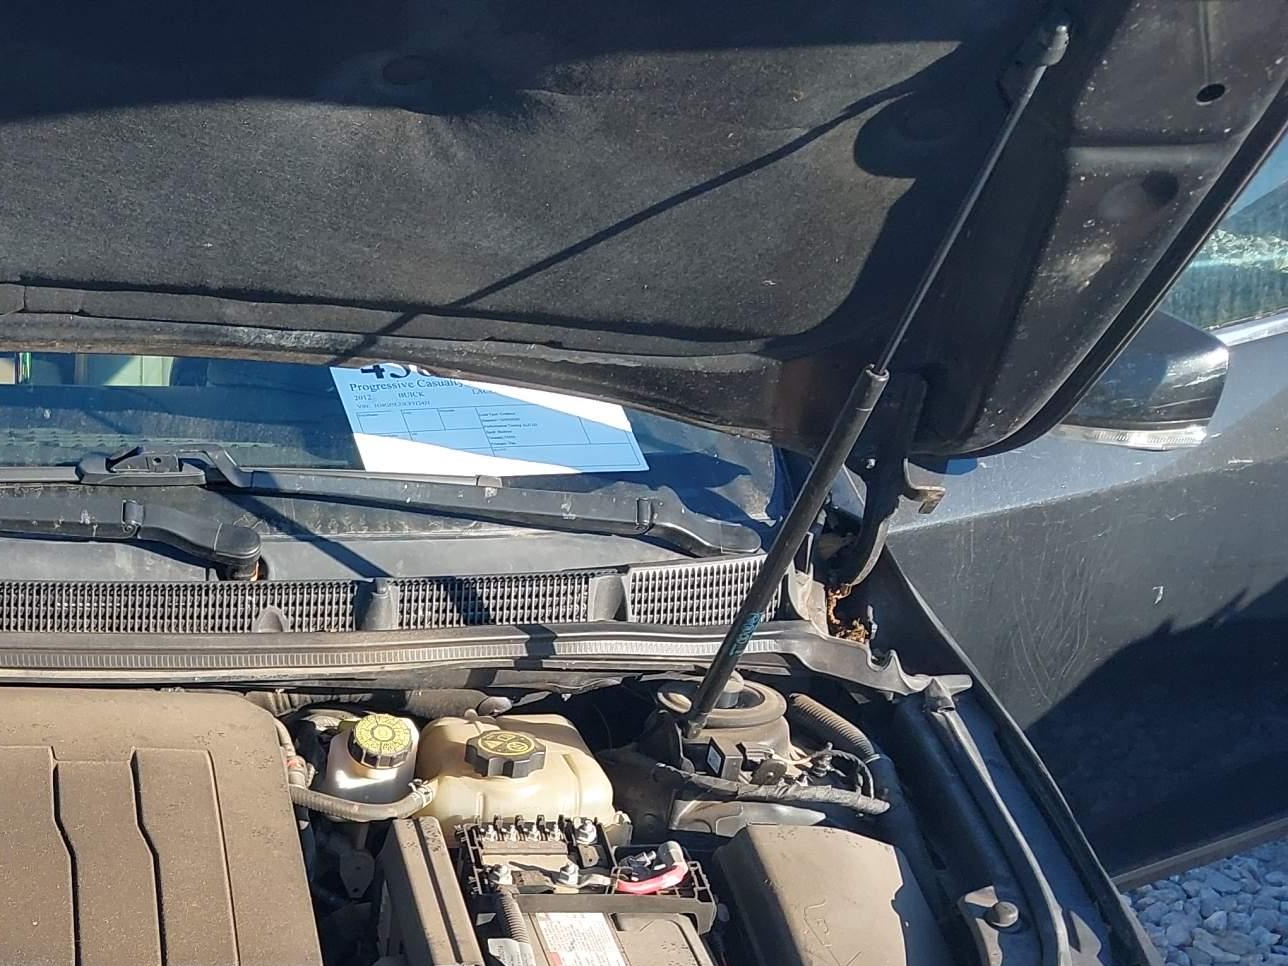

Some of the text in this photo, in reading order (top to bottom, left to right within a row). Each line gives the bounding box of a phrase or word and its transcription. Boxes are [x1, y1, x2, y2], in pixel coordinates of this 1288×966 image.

[349, 380, 464, 393] Progressive Casualty
[398, 391, 425, 399] BUICK
